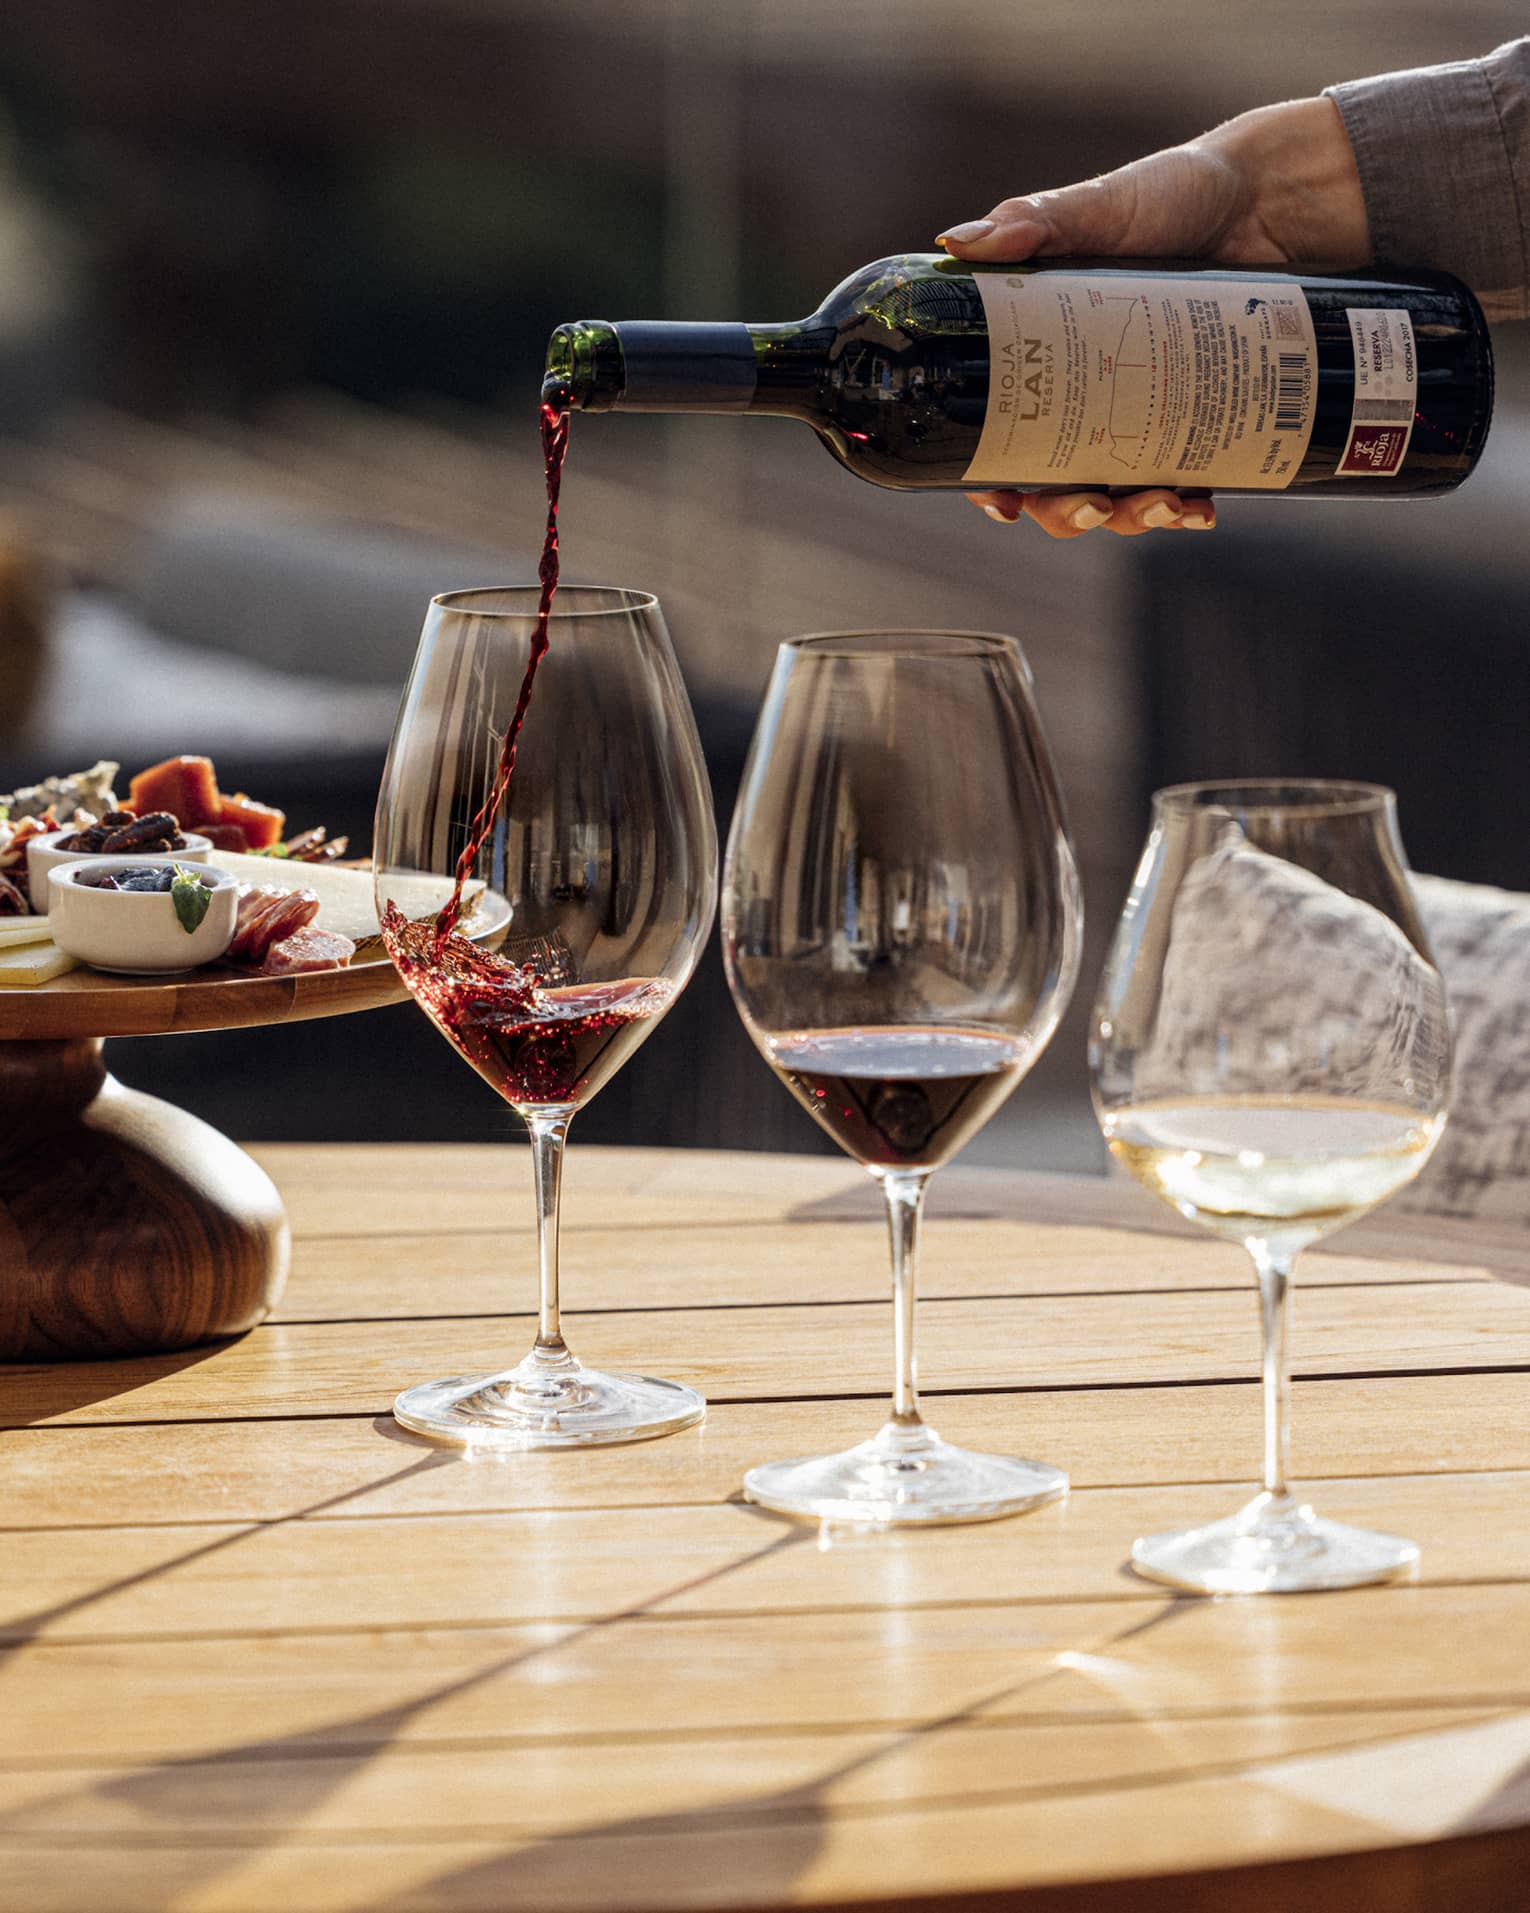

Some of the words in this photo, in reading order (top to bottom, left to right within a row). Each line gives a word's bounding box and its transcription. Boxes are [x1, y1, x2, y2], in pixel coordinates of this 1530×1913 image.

[1371, 330, 1382, 372] RESERVA
[1400, 322, 1410, 340] 2017
[999, 343, 1016, 414] RIOJA
[1020, 339, 1042, 421] LAN
[1041, 344, 1054, 416] RESERVA
[1360, 371, 1368, 385] UE
[1404, 342, 1413, 382] COSECHA
